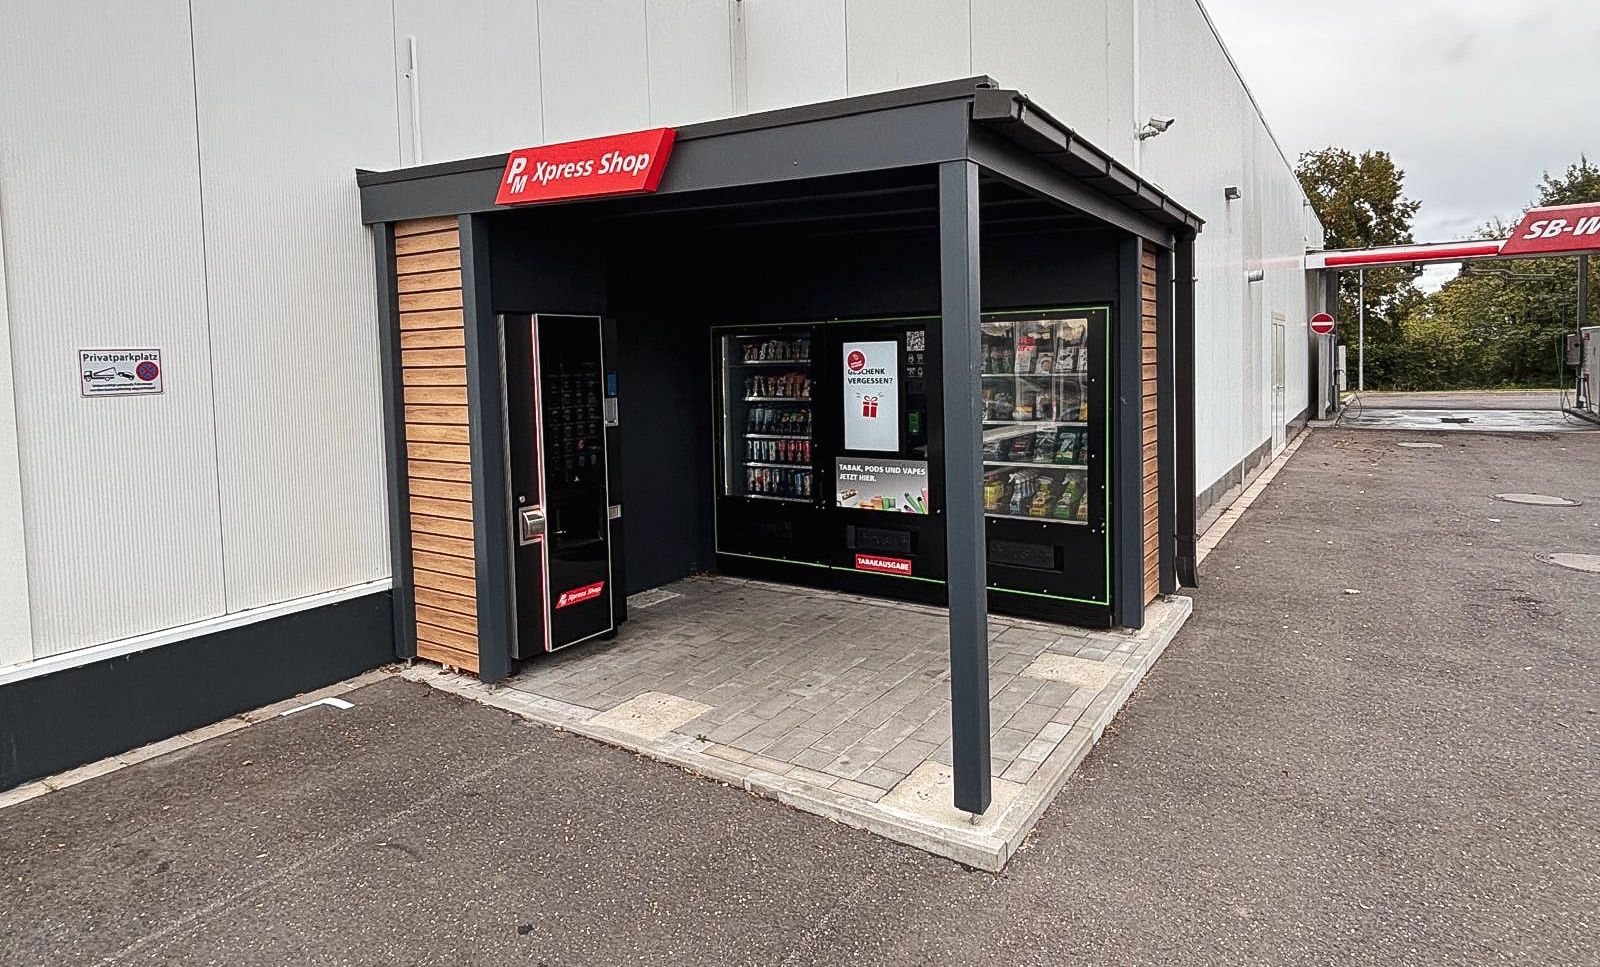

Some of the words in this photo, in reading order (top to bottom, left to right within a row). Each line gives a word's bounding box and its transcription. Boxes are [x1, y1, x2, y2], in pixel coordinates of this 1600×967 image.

[532, 159, 594, 186] Xpress
[598, 150, 650, 176] Shop
[1522, 216, 1600, 239] SB-W
[82, 352, 158, 363] Privatparkplatz
[839, 464, 863, 472] TABAK,
[864, 465, 884, 473] PODS
[885, 466, 901, 474] UND
[902, 467, 926, 475] VAPES
[839, 473, 858, 481] JETZT
[857, 557, 909, 571] TABAKAUSGABE
